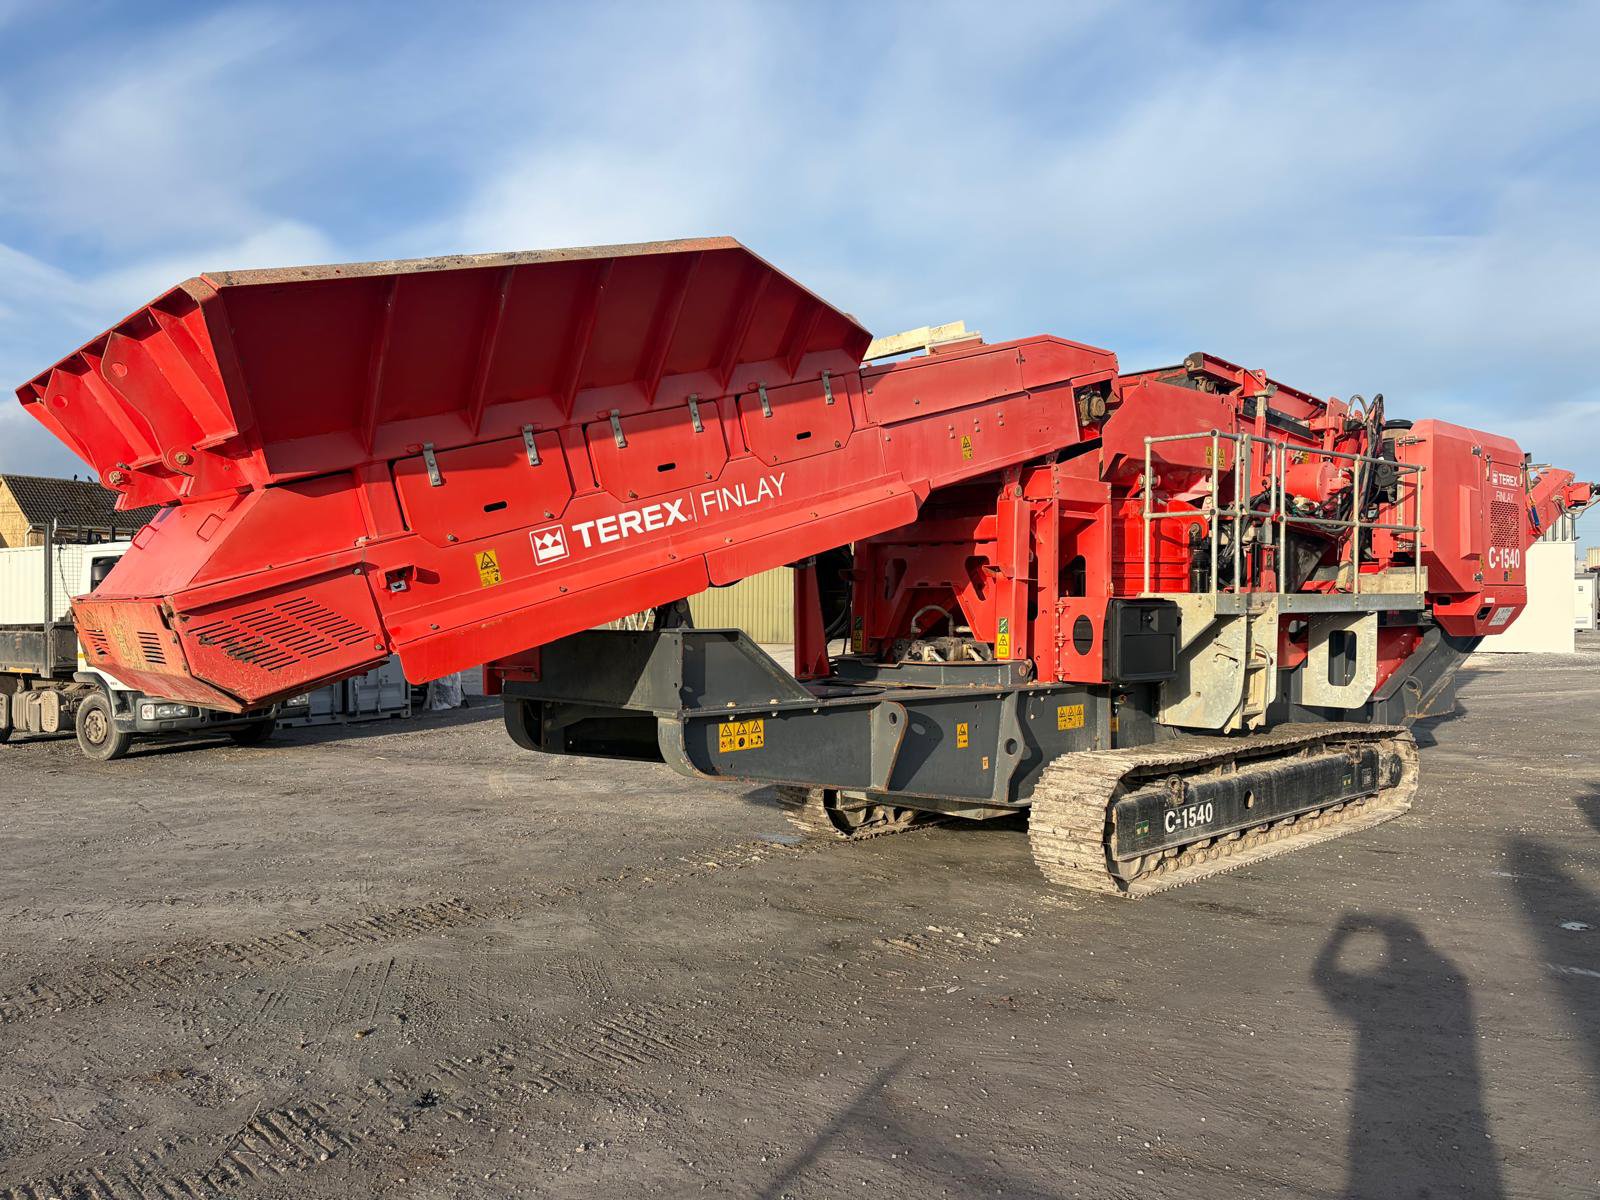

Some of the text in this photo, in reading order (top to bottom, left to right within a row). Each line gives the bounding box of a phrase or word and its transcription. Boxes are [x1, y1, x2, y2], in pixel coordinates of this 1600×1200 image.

[1499, 472, 1519, 487] TEREX
[572, 472, 786, 548] TEREX FINLAY
[1488, 546, 1520, 569] C-1540
[1165, 802, 1213, 833] C-1540
